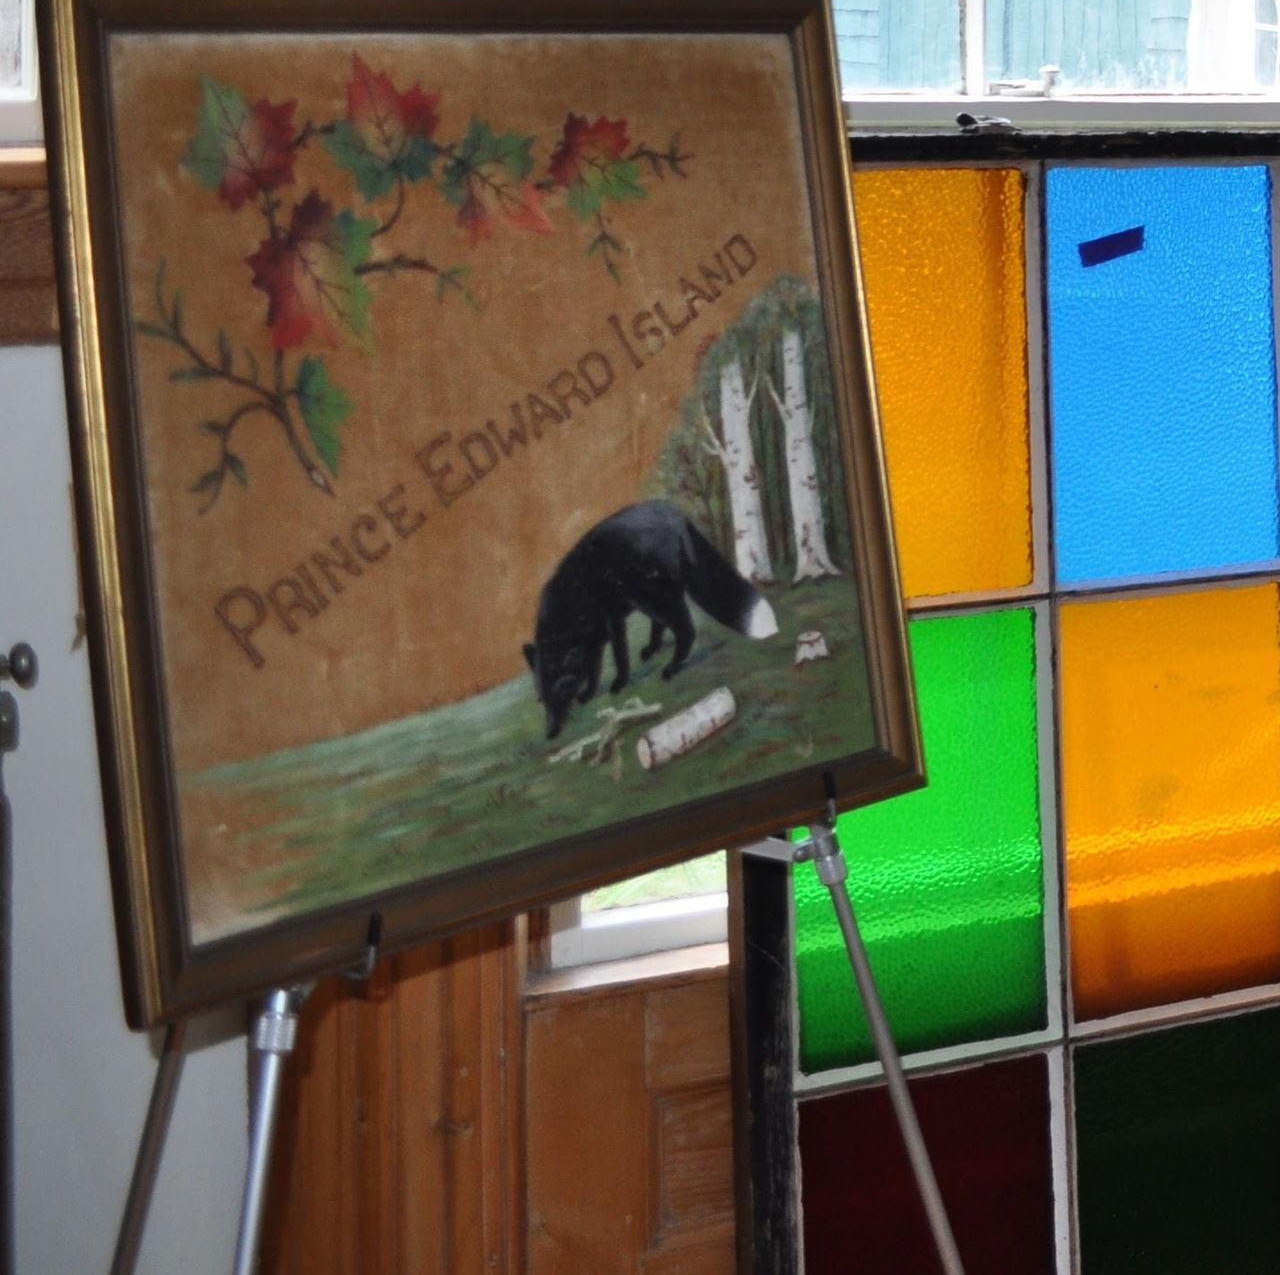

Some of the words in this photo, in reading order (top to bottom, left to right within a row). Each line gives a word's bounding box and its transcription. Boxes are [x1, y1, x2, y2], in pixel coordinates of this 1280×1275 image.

[214, 485, 428, 670] PRINCE
[415, 352, 617, 506] EDWARD
[607, 232, 759, 371] ISLAND
